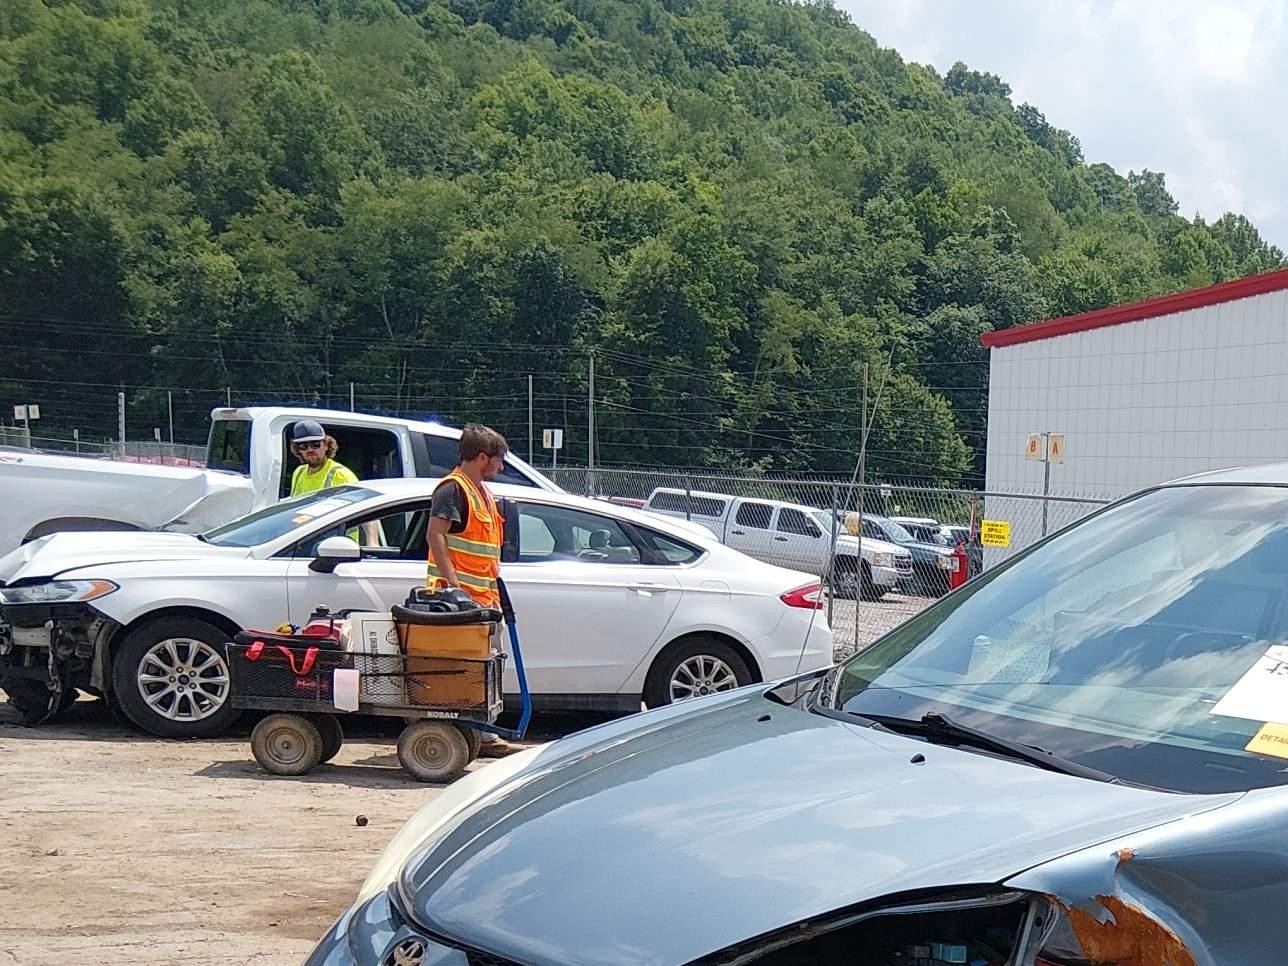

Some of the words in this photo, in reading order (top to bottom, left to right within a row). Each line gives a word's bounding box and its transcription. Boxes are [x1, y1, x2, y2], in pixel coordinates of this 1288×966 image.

[1030, 439, 1037, 453] B
[1052, 441, 1059, 455] A
[427, 710, 459, 719] KOBALT
